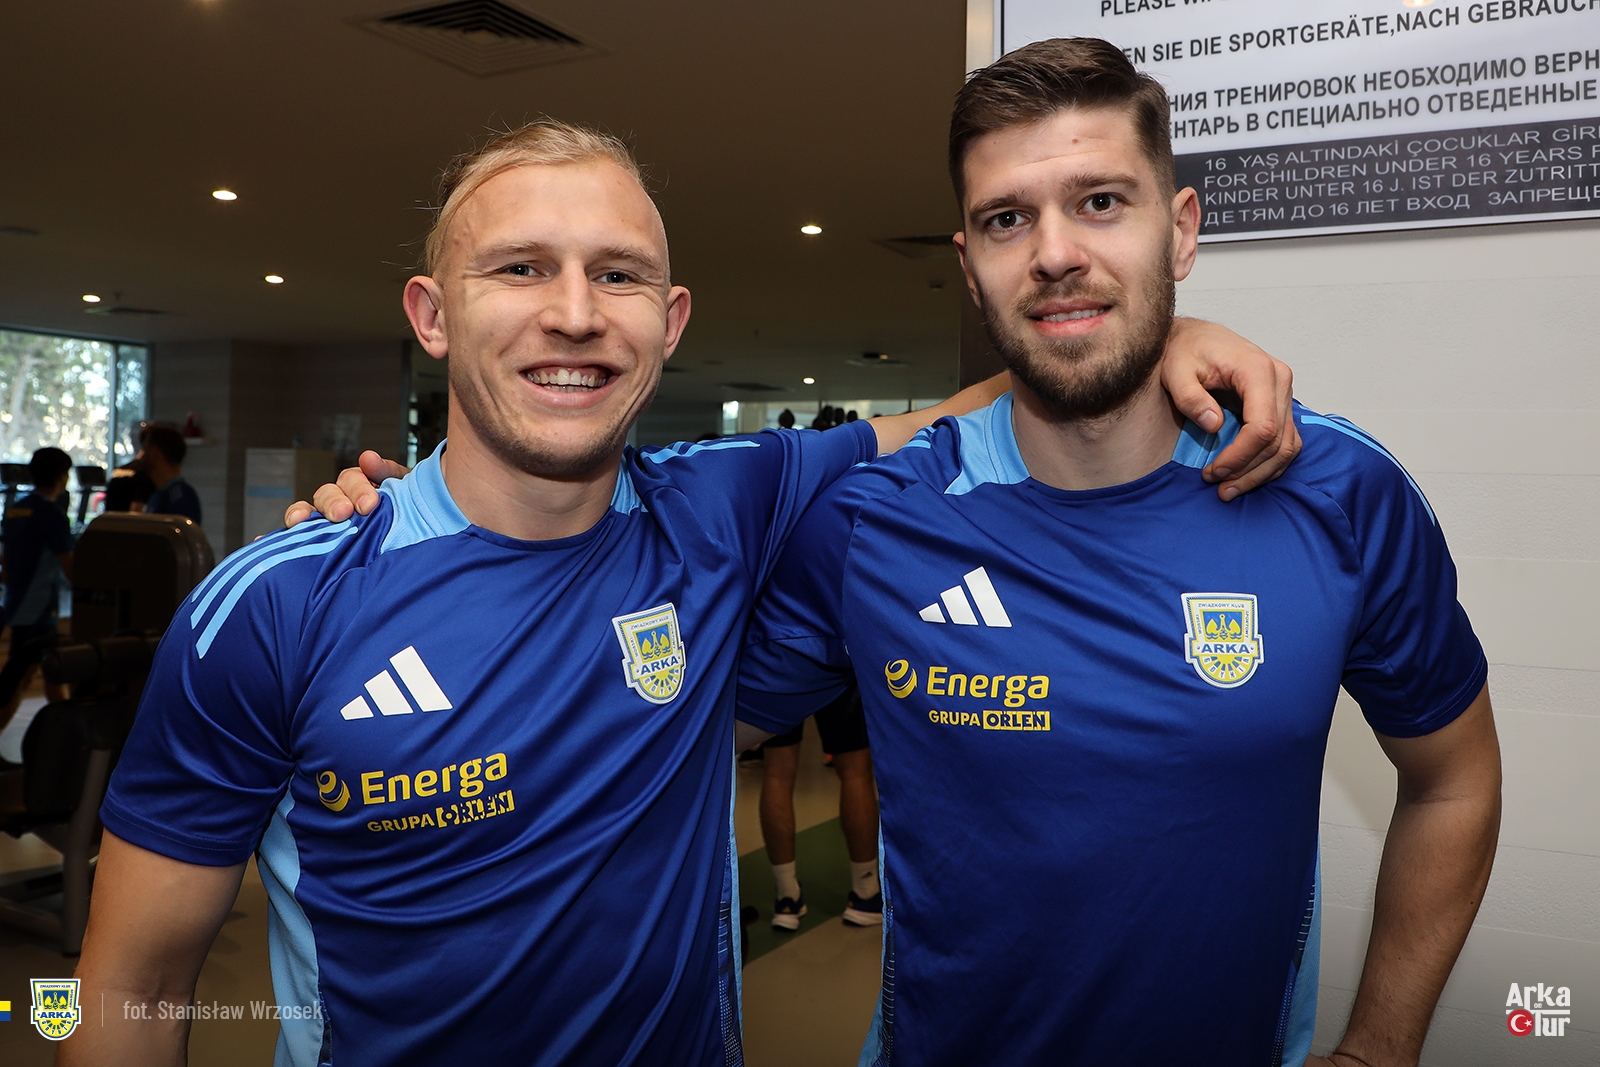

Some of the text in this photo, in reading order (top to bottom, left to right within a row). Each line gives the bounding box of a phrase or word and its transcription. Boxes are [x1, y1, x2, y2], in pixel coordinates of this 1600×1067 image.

[1152, 41, 1183, 62] SIE
[1190, 36, 1222, 57] DIE
[1214, 74, 1356, 108] ТРЕНИРОВОК
[1363, 57, 1527, 92] НЕОБХОДИМО
[1534, 49, 1600, 75] ВЕРН
[1169, 79, 1598, 139] НТАРЬ В СПЕЦИАЛЬНО ОТВЕДЕННЫЕ
[1204, 157, 1227, 171] 16
[1238, 153, 1280, 169] YAŞ
[1285, 140, 1399, 164] ALTINDAKİ
[1406, 130, 1541, 157] ÇOCUKLAR
[1204, 173, 1248, 188] FOR
[1254, 163, 1367, 185] CHILDREN
[1375, 156, 1458, 175] UNDER
[1466, 153, 1491, 168] 16
[1498, 146, 1583, 165] YEARS
[1205, 163, 1600, 206] KINDER UNTER 16 J. IST DER ZUTRITT
[1204, 206, 1285, 227] ДЕТЯМ
[1291, 204, 1325, 221] ДО
[1329, 202, 1349, 216] 16
[1355, 199, 1400, 215] ЛЕТ
[1406, 193, 1470, 211] ВХОД
[640, 655, 679, 675] ARKA
[1201, 643, 1250, 654] ARKA
[927, 665, 1050, 708] Energa
[928, 709, 1048, 729] GRUPA ORLEN
[360, 752, 508, 805] Energa
[366, 791, 512, 832] GRUPA ORLEN
